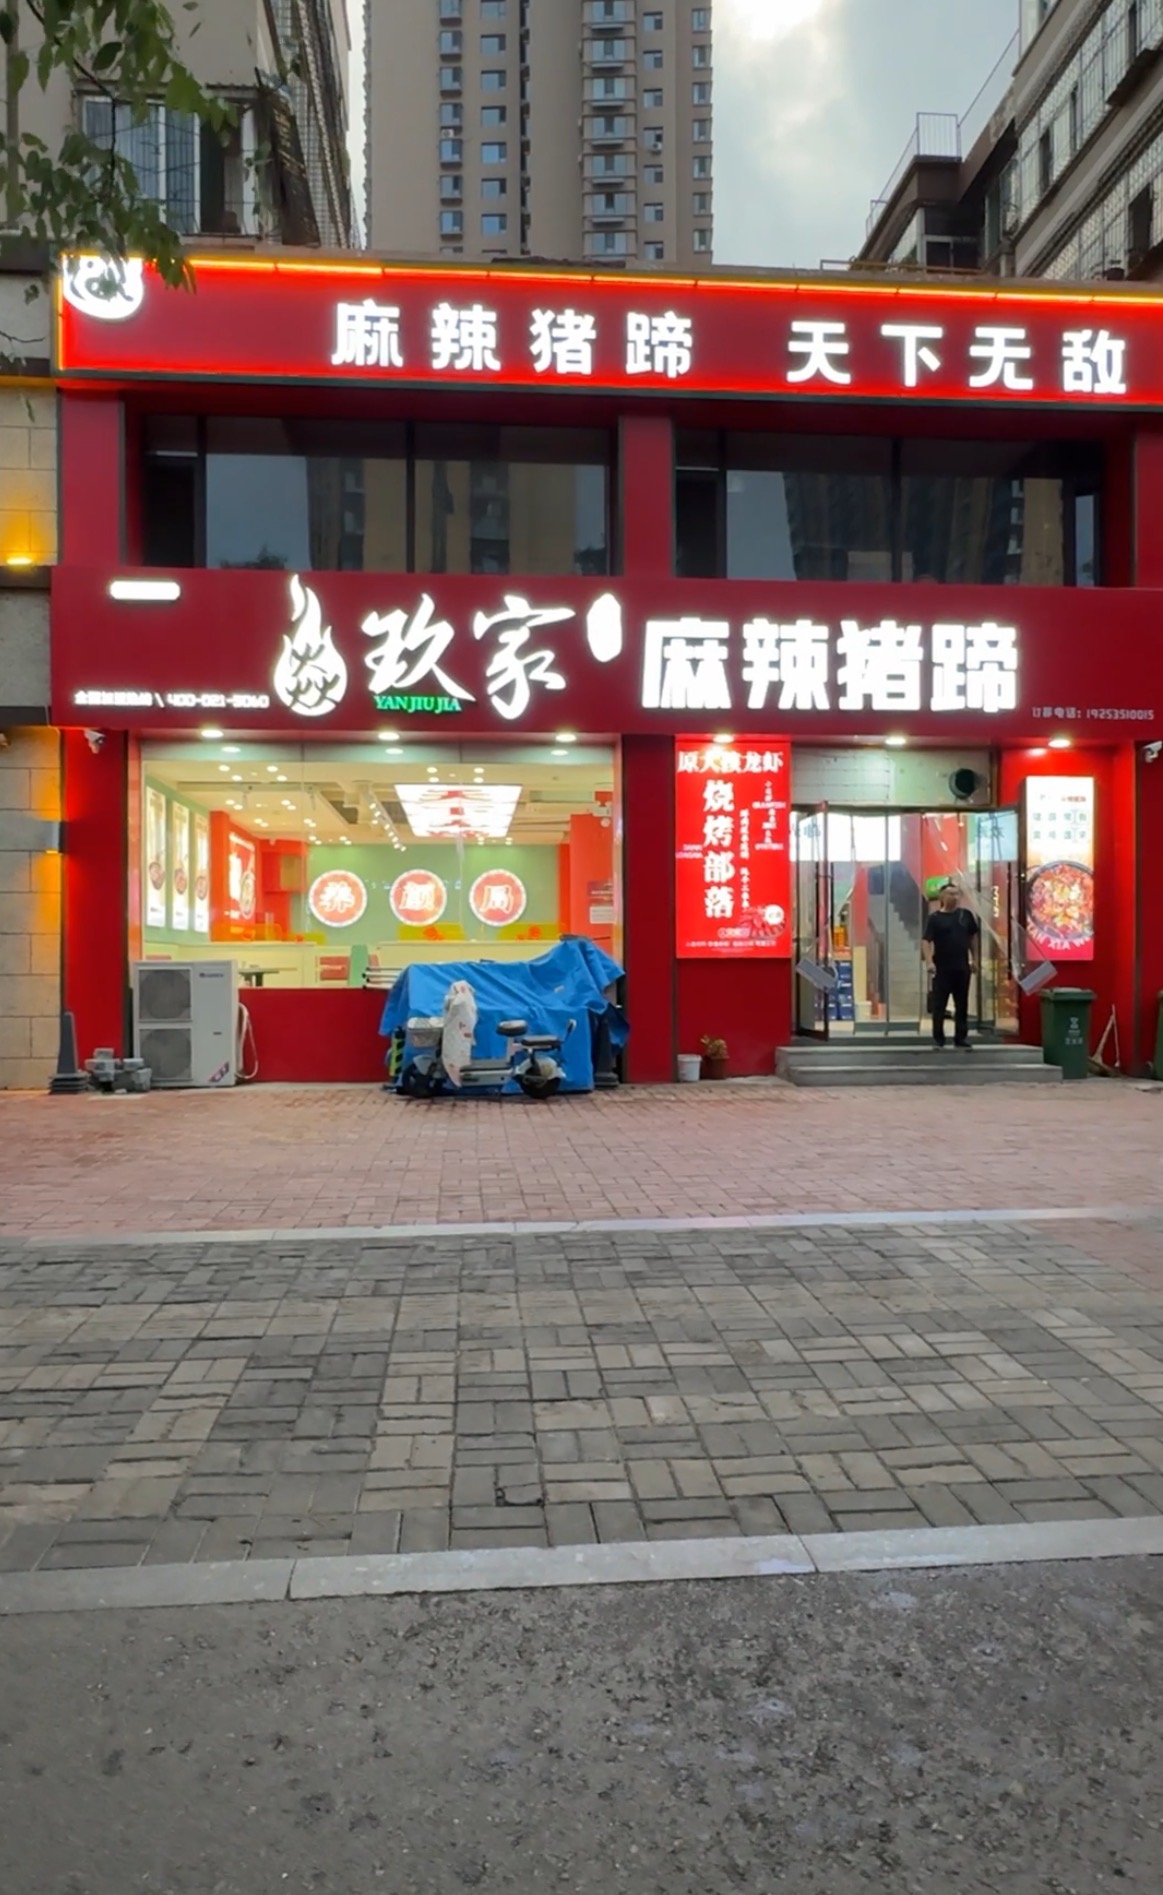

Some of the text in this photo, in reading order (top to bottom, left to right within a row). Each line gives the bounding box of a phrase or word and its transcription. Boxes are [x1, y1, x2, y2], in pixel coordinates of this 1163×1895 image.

[330, 298, 1127, 395] 麻辣猪蹄 天下无敌
[361, 592, 576, 720] 玖家
[641, 616, 1019, 714] 麻辣猪蹄
[373, 695, 462, 714] YAN JIU JIA
[703, 779, 735, 918] 烧烤部落
